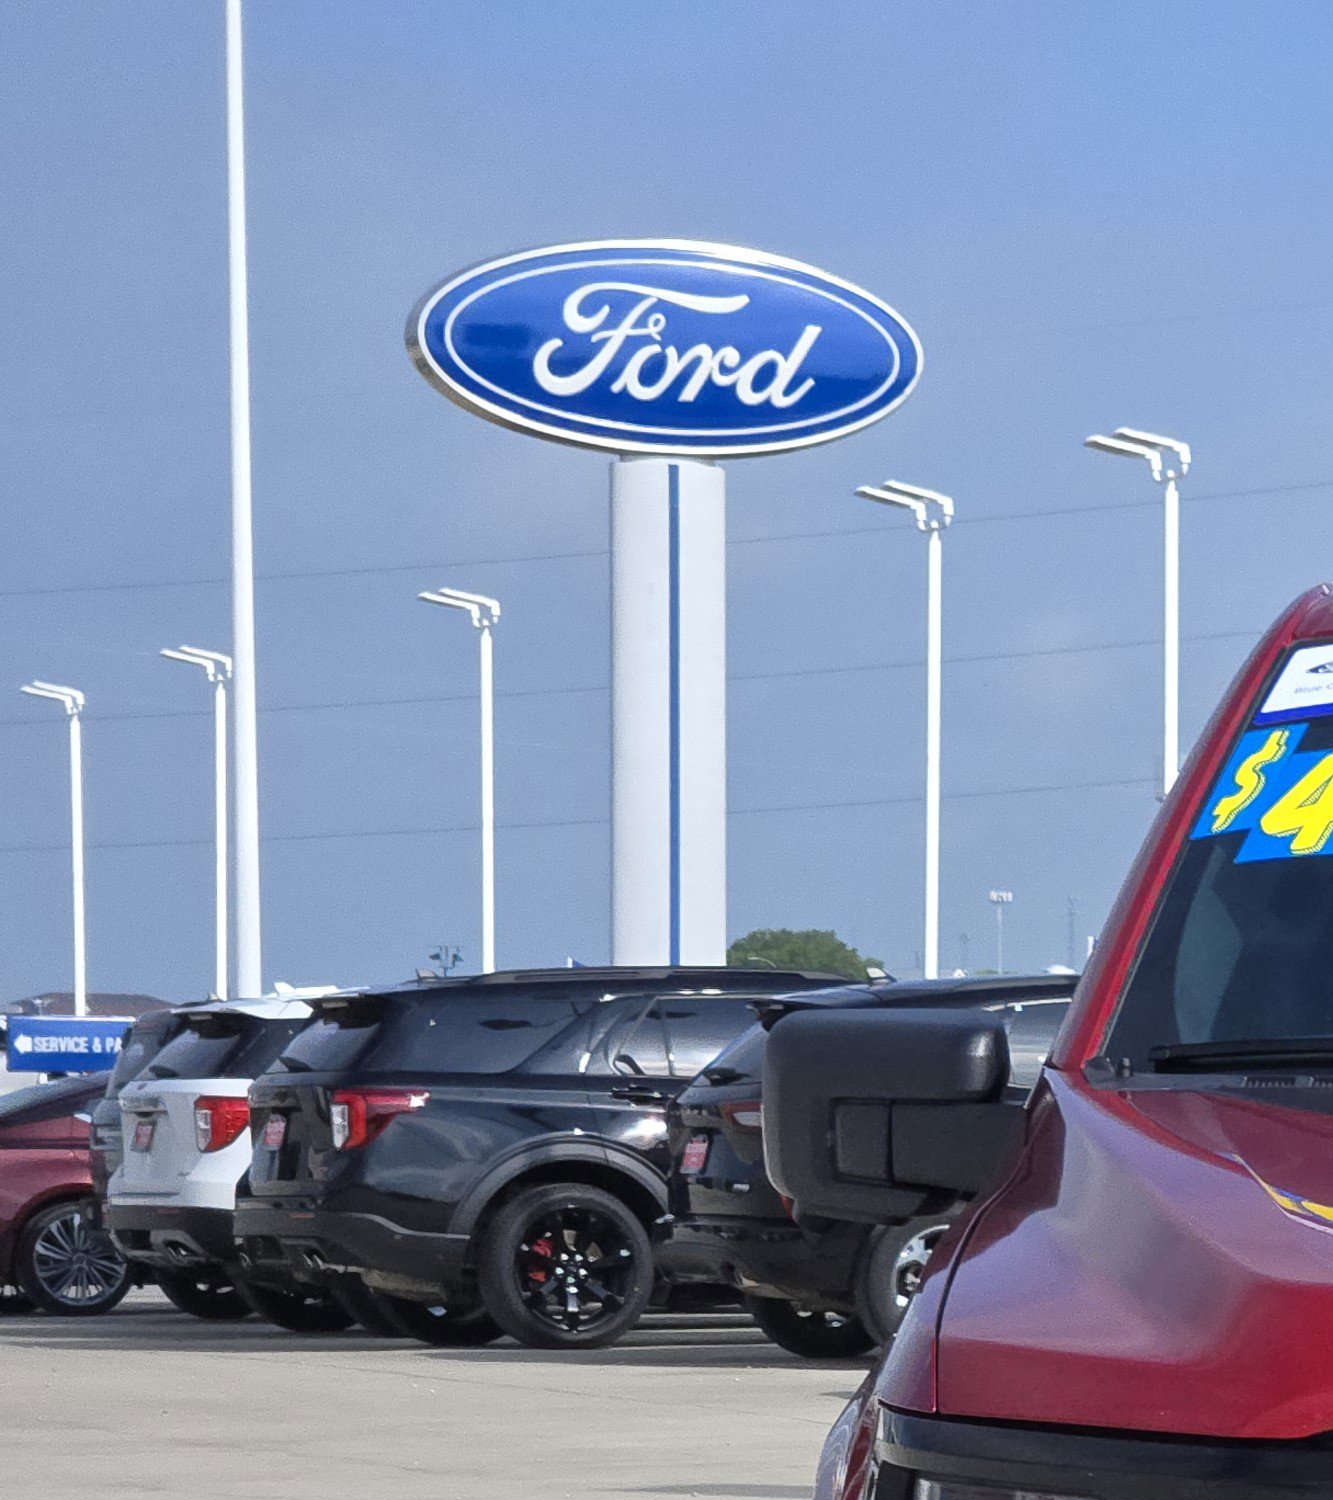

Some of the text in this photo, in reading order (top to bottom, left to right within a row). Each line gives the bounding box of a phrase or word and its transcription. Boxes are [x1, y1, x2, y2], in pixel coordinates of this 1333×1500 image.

[533, 281, 822, 409] Ford
[33, 1036, 89, 1053] SERVICE
[92, 1036, 102, 1053] &
